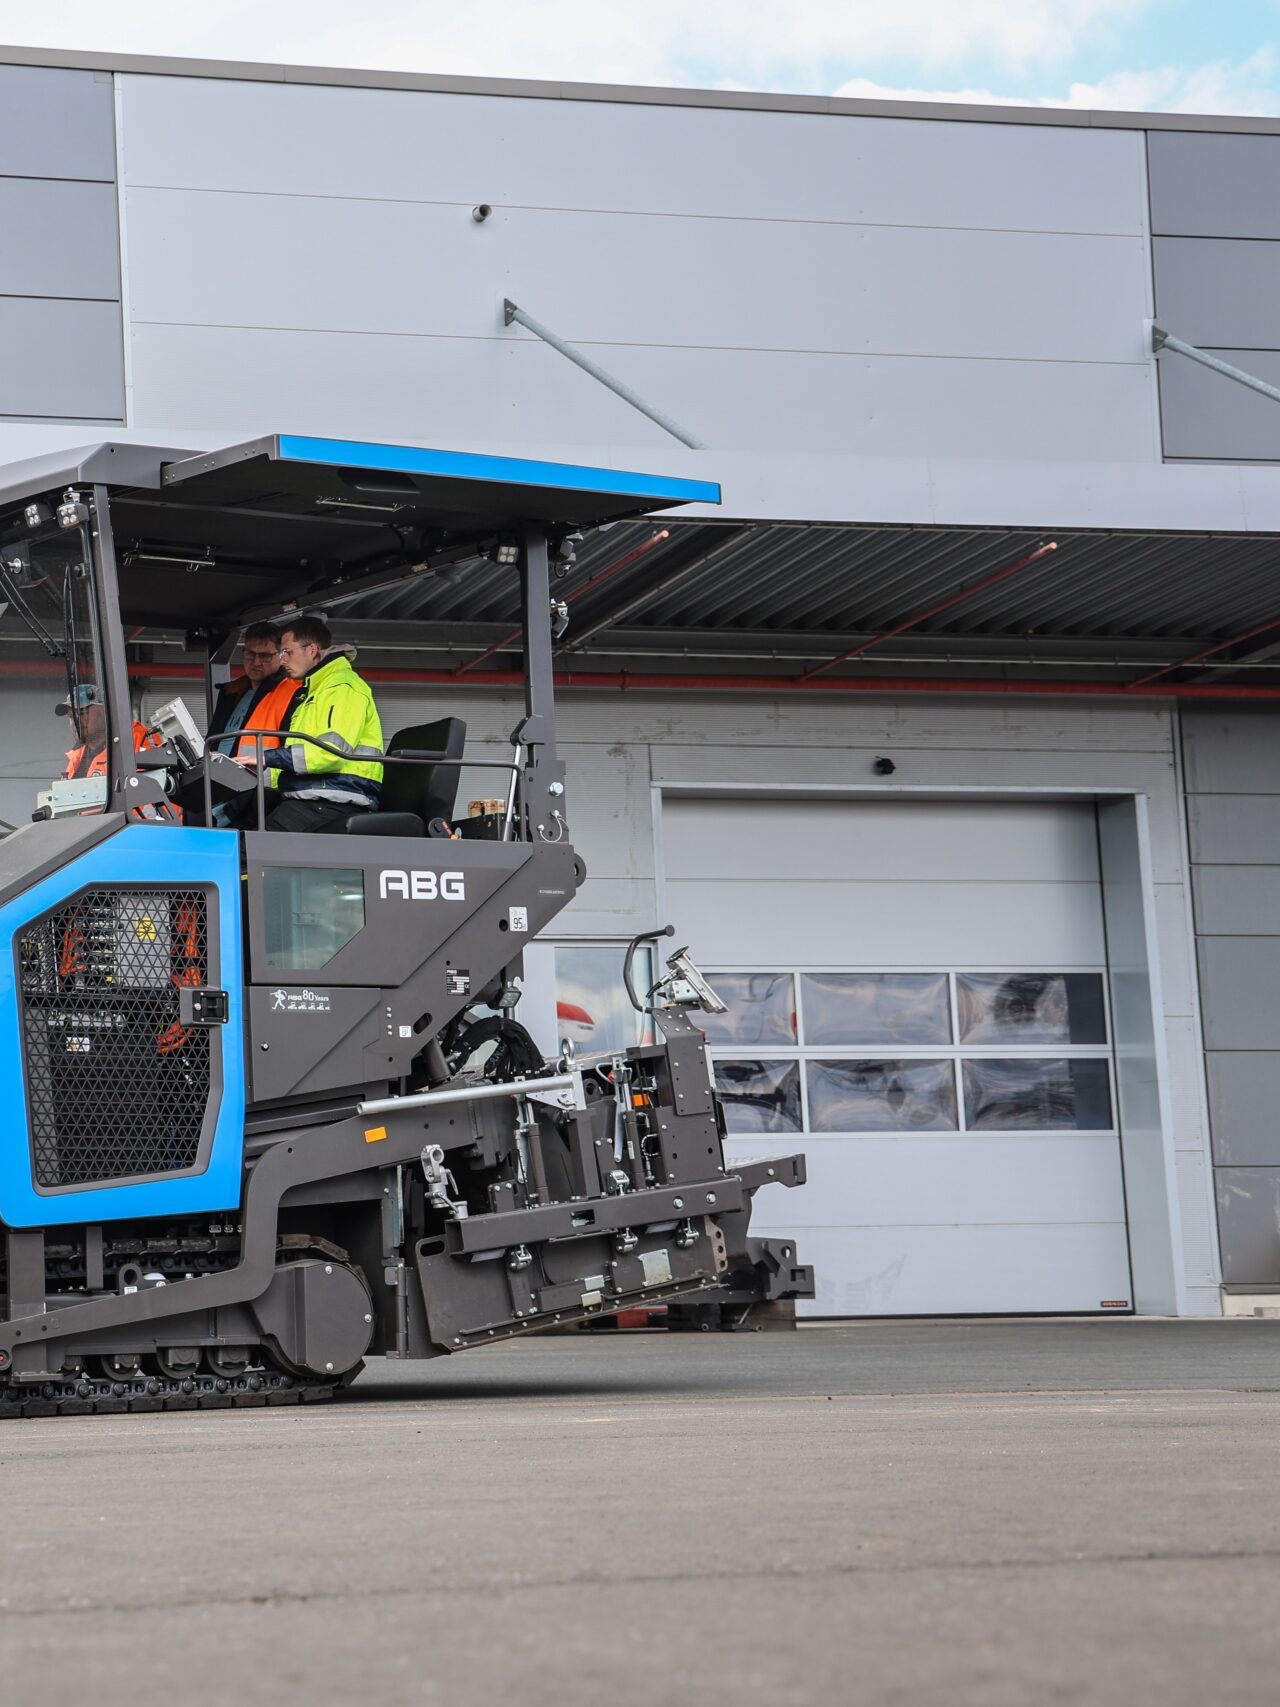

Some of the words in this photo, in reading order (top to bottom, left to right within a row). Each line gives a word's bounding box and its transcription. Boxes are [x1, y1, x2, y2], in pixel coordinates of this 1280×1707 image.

[380, 869, 465, 900] ABG
[513, 917, 523, 930] 95
[302, 989, 314, 1001] 80
